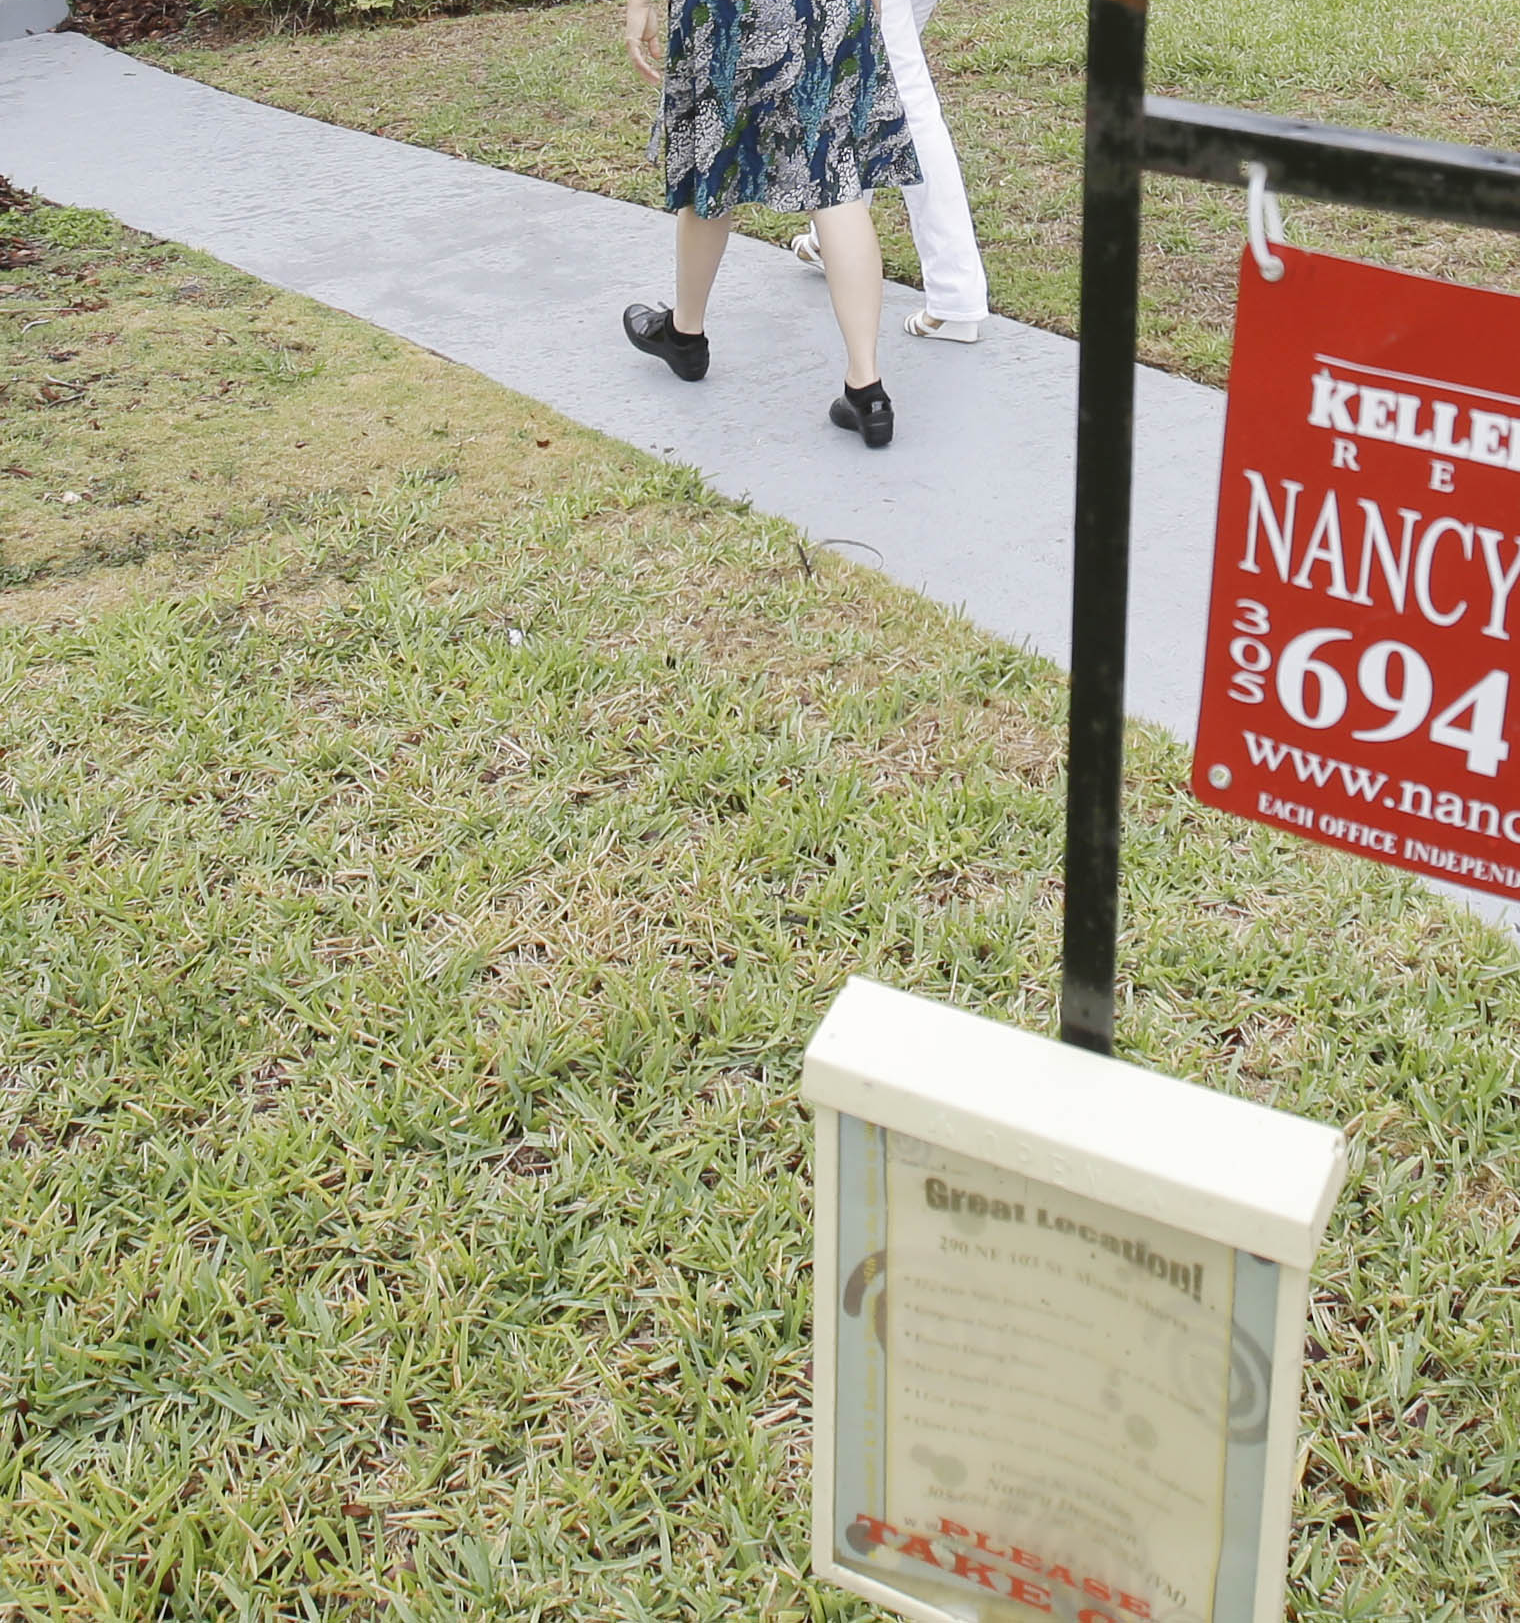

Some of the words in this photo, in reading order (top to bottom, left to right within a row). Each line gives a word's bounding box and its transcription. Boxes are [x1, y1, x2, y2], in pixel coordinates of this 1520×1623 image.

[1227, 598, 1272, 704] 305
[1258, 792, 1314, 829] EACH
[1318, 814, 1398, 855] OFFICE
[925, 1177, 1026, 1224] Great
[1036, 1209, 1205, 1303] Location!
[940, 1235, 969, 1255] 290
[856, 1513, 1053, 1613] TAKE
[938, 1517, 1152, 1619] PLEASE
